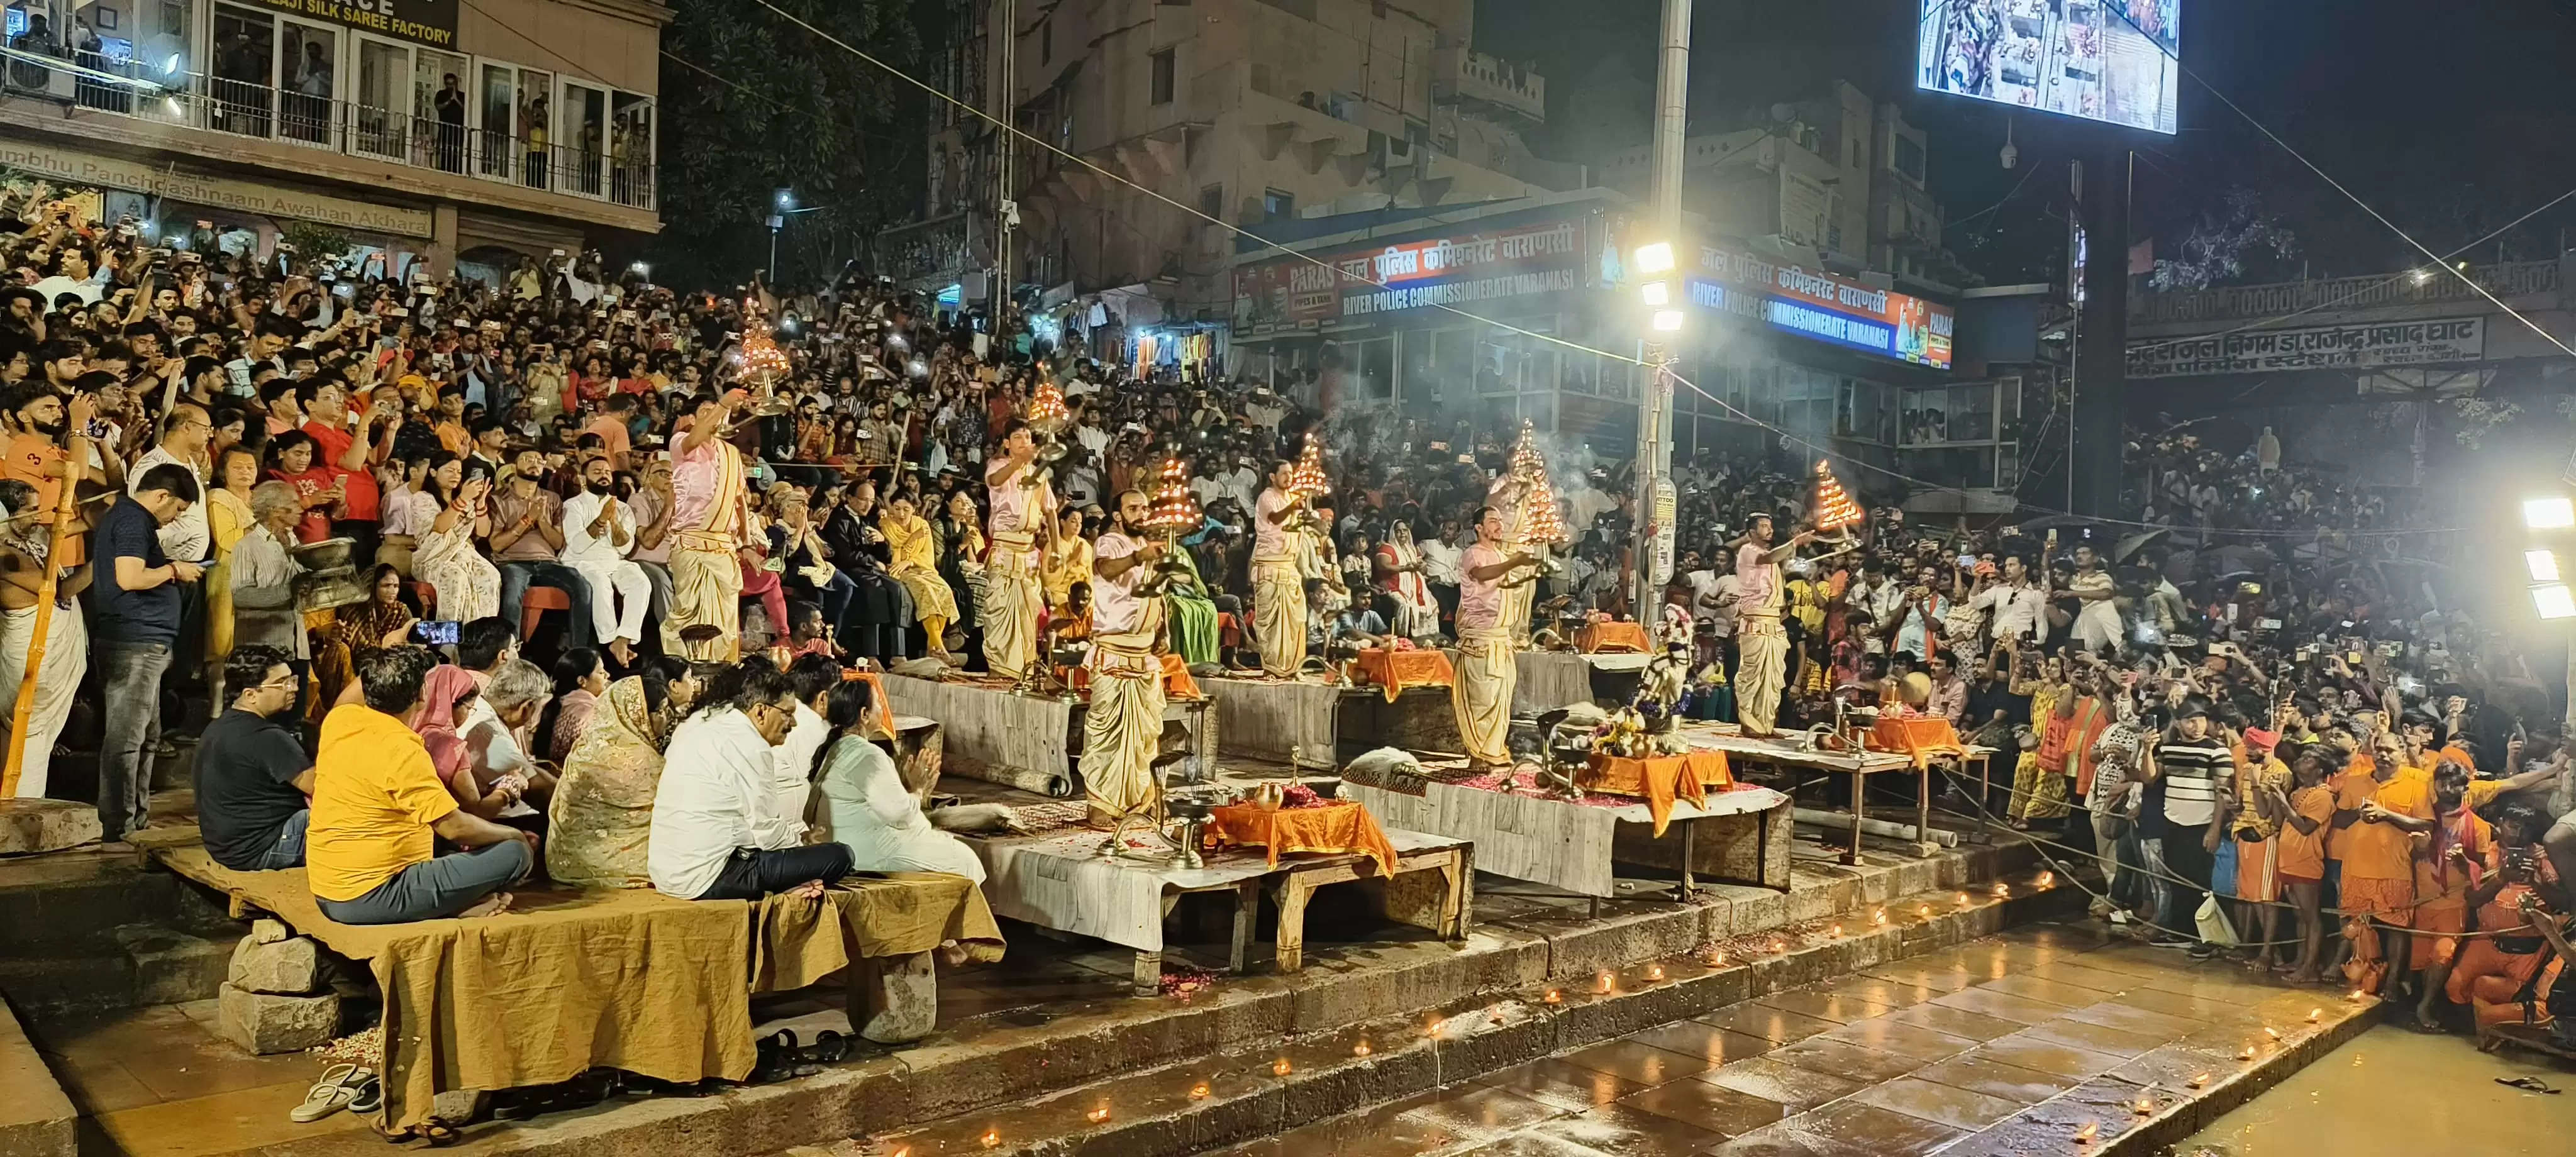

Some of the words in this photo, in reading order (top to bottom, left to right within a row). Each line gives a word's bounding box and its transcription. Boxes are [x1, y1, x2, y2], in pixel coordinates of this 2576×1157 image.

[307, 0, 339, 18] SILK
[343, 7, 388, 30] SAREE
[392, 18, 451, 44] FACTORY
[273, 197, 352, 221] Awahan
[358, 210, 427, 233] Akhara
[1340, 258, 1369, 282] जल
[1374, 246, 1418, 284] पुलिस
[1500, 222, 1575, 259] वाराणसी
[1290, 262, 1335, 292] PARAS
[1343, 294, 1372, 315] RIVER
[1374, 288, 1408, 311] POLICE
[1409, 275, 1513, 306] COMMISSIONERATE
[1515, 268, 1573, 294] VARANASI
[1734, 252, 1774, 284] पुलिस
[1839, 284, 1887, 314] वाराणसी
[1693, 281, 1723, 309] RIVER
[1725, 289, 1760, 318] POLICE
[1760, 299, 1847, 339] COMMISSIONERATE
[1847, 320, 1889, 349] VARANASI
[2425, 320, 2476, 341] घाट
[27, 453, 42, 465] 3
